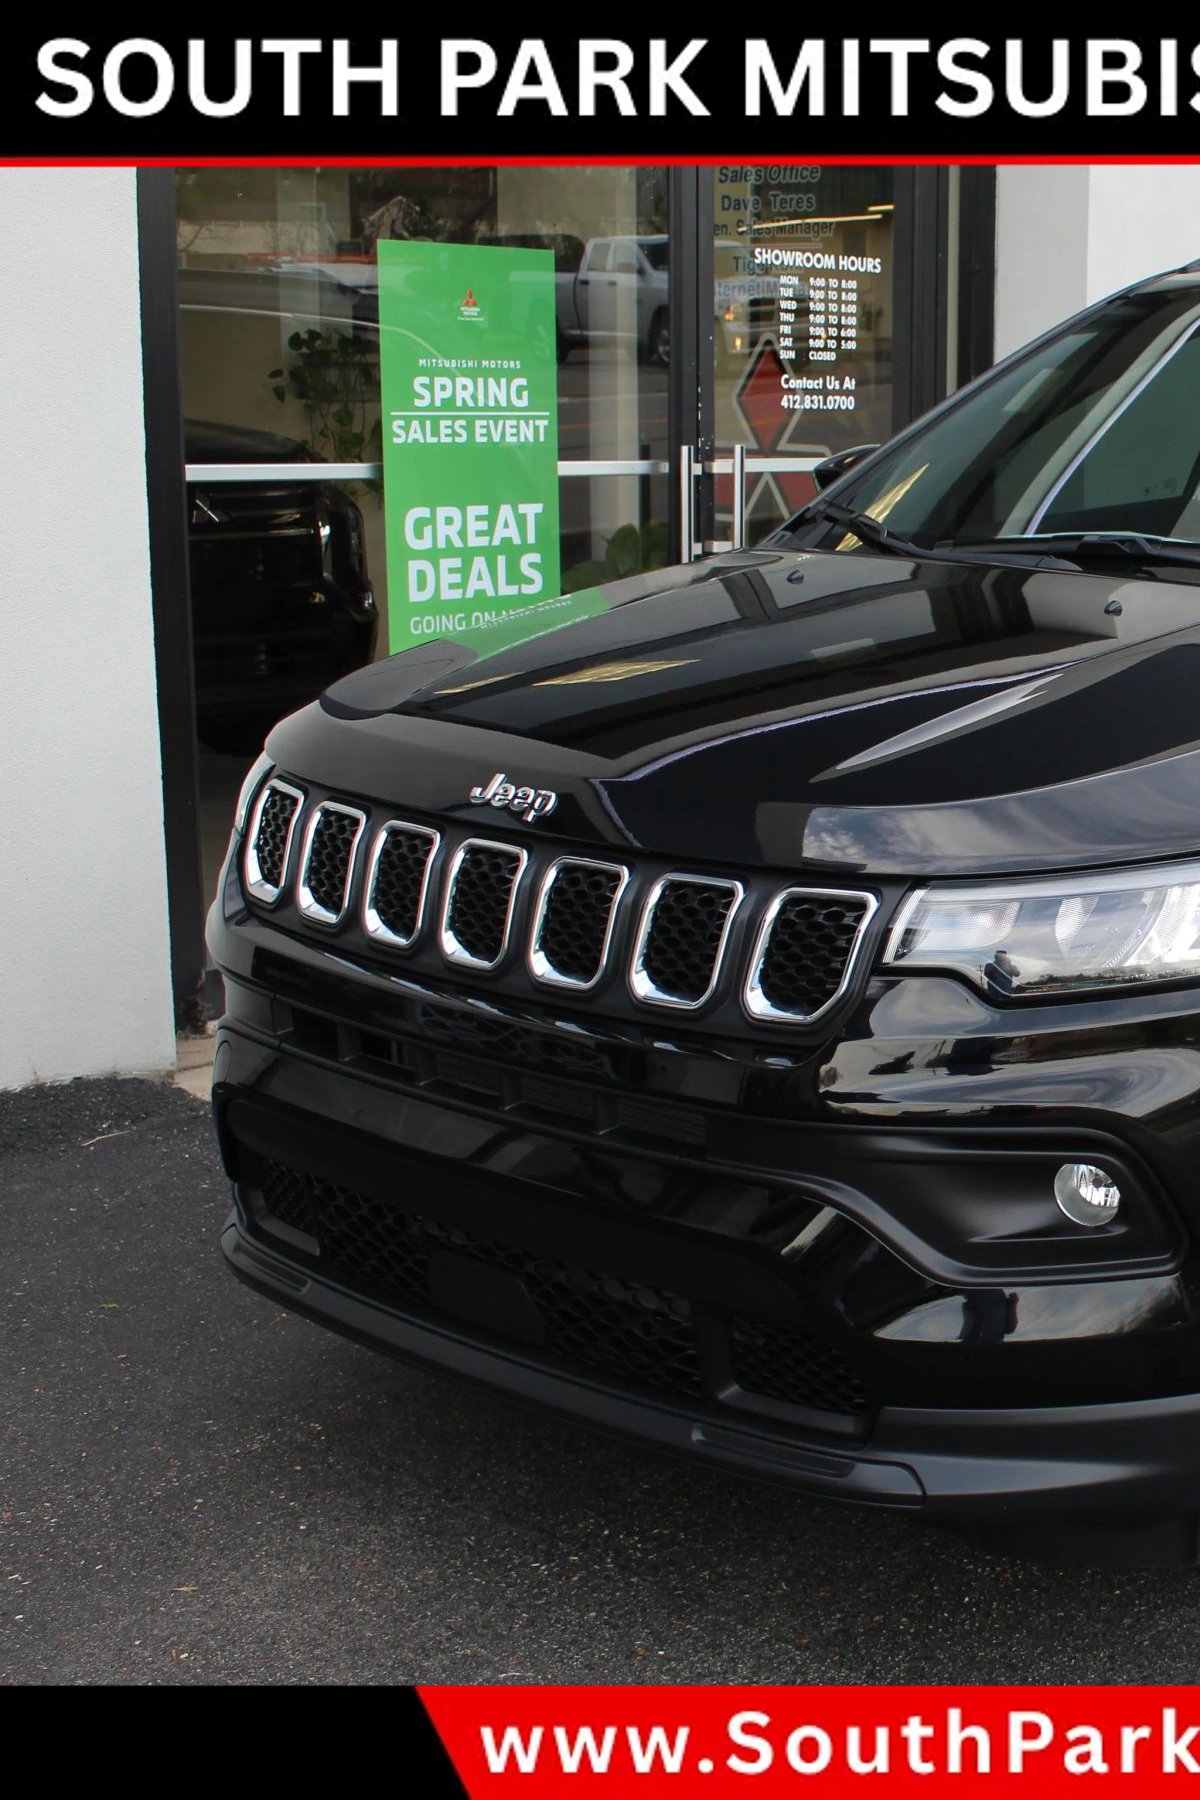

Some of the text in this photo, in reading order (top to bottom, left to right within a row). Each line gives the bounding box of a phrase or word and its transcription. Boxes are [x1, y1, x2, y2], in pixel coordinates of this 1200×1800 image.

[718, 166, 821, 184] Sales Office
[721, 191, 816, 212] Dave Teres
[755, 248, 835, 270] SHOWROOM
[838, 255, 881, 273] HOURS
[780, 275, 857, 289] MON 9:00 TO 8:00
[780, 288, 794, 297] TUE
[809, 290, 825, 299] 9:00
[828, 291, 838, 300] TO
[841, 292, 857, 301] 8:00
[780, 300, 857, 313] WED 9:00 TO 8:00
[780, 313, 857, 325] THU 9:00 TO 8:00
[780, 325, 857, 338] FRI 9:00 TO 6:00
[780, 338, 857, 349] SAT 9:00 TO 5:00
[780, 350, 836, 361] SUN CLOSED
[419, 359, 521, 369] MITSUBISHI MOTORS
[781, 374, 856, 390] Contact Us At
[413, 376, 529, 408] SPRING
[780, 395, 855, 410] 412.831.0700
[392, 420, 549, 444] SALES EVENT
[405, 503, 543, 550] GREAT
[408, 553, 543, 603] DEALS
[410, 613, 466, 635] GOING
[470, 773, 558, 824] Jeep
